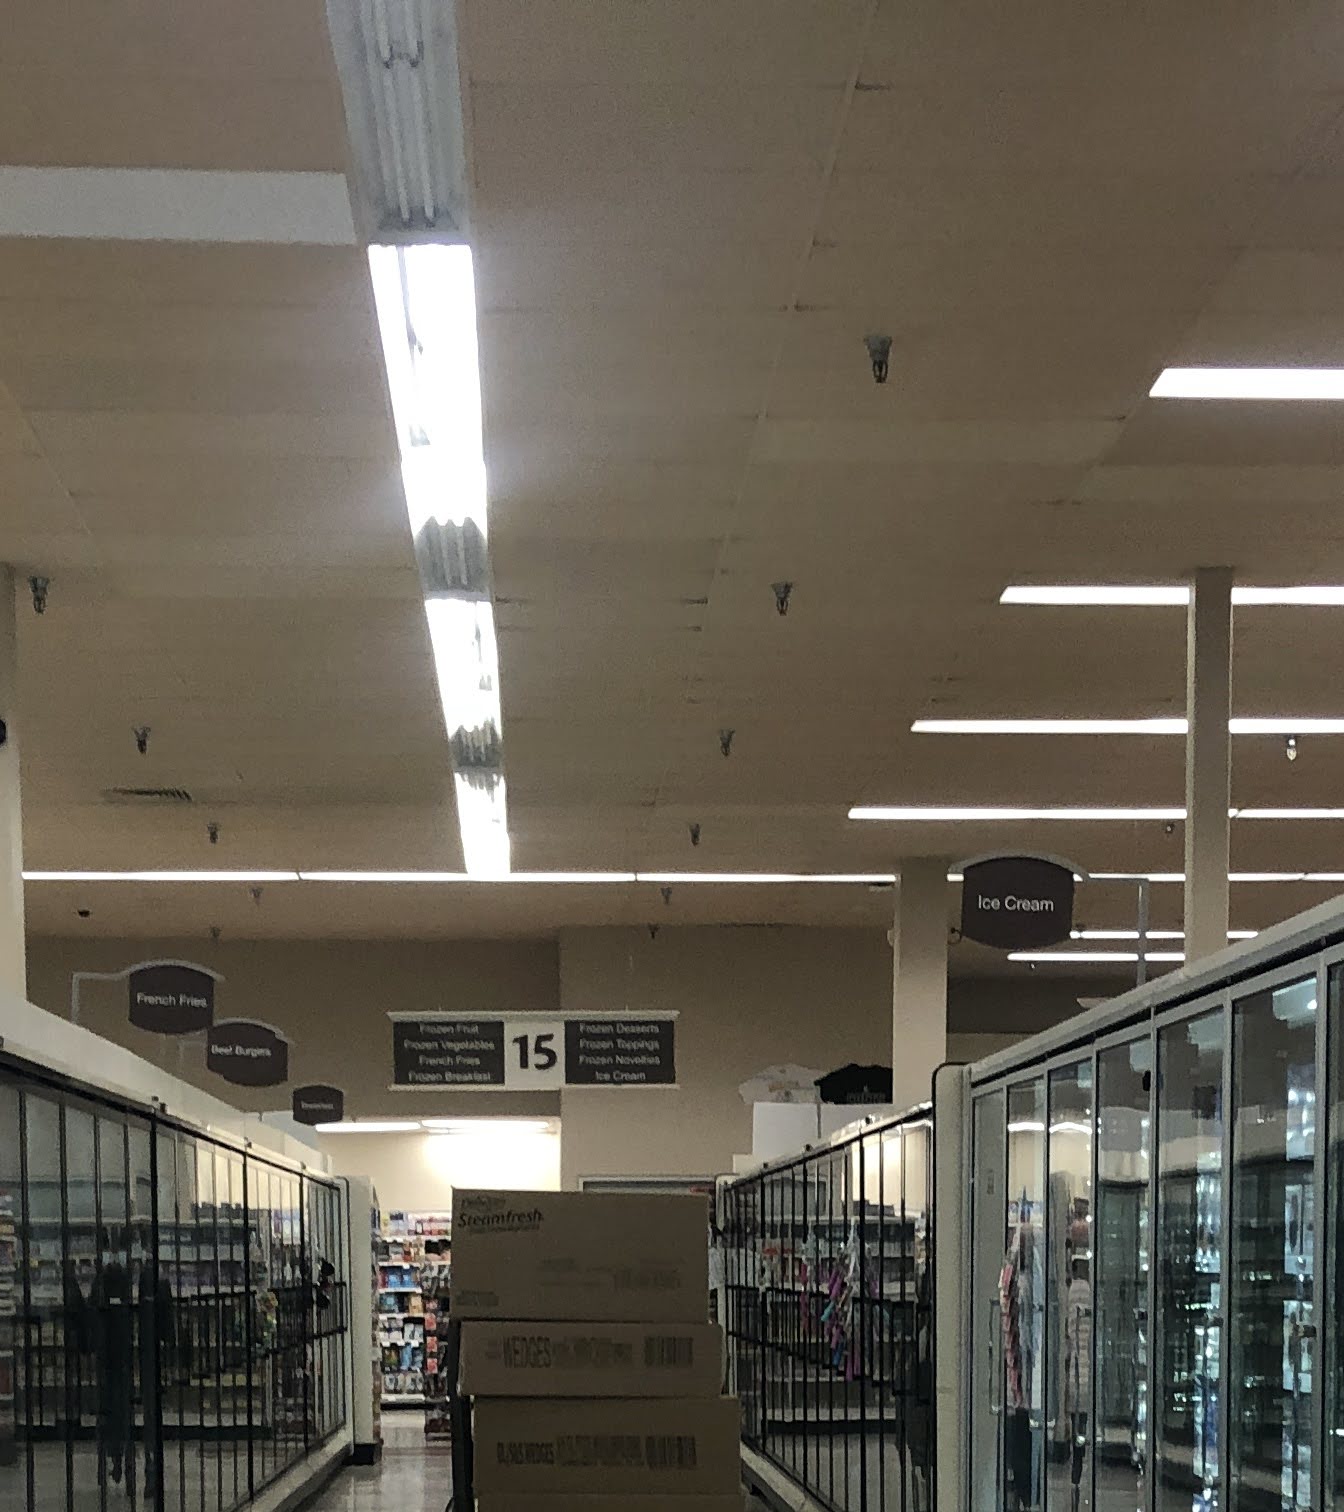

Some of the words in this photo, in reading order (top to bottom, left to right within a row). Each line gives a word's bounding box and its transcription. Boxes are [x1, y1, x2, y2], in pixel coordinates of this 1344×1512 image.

[977, 894, 1000, 911] Ice
[1004, 895, 1054, 912] Cream
[136, 992, 176, 1007] French
[179, 993, 208, 1009] Fries
[419, 1023, 454, 1034] Frozen
[579, 1023, 613, 1034] Frozen
[235, 1045, 272, 1058] Burgers
[440, 1039, 495, 1052] Vegetables
[512, 1034, 557, 1070] 15
[579, 1039, 613, 1050] Frozen
[616, 1039, 660, 1052] Toppings
[419, 1055, 453, 1066] French
[455, 1055, 480, 1066] Fries
[579, 1055, 613, 1065] Frozen
[595, 1071, 610, 1081] Ice
[613, 1070, 646, 1081] Cream
[457, 1207, 544, 1229] Steamfresh
